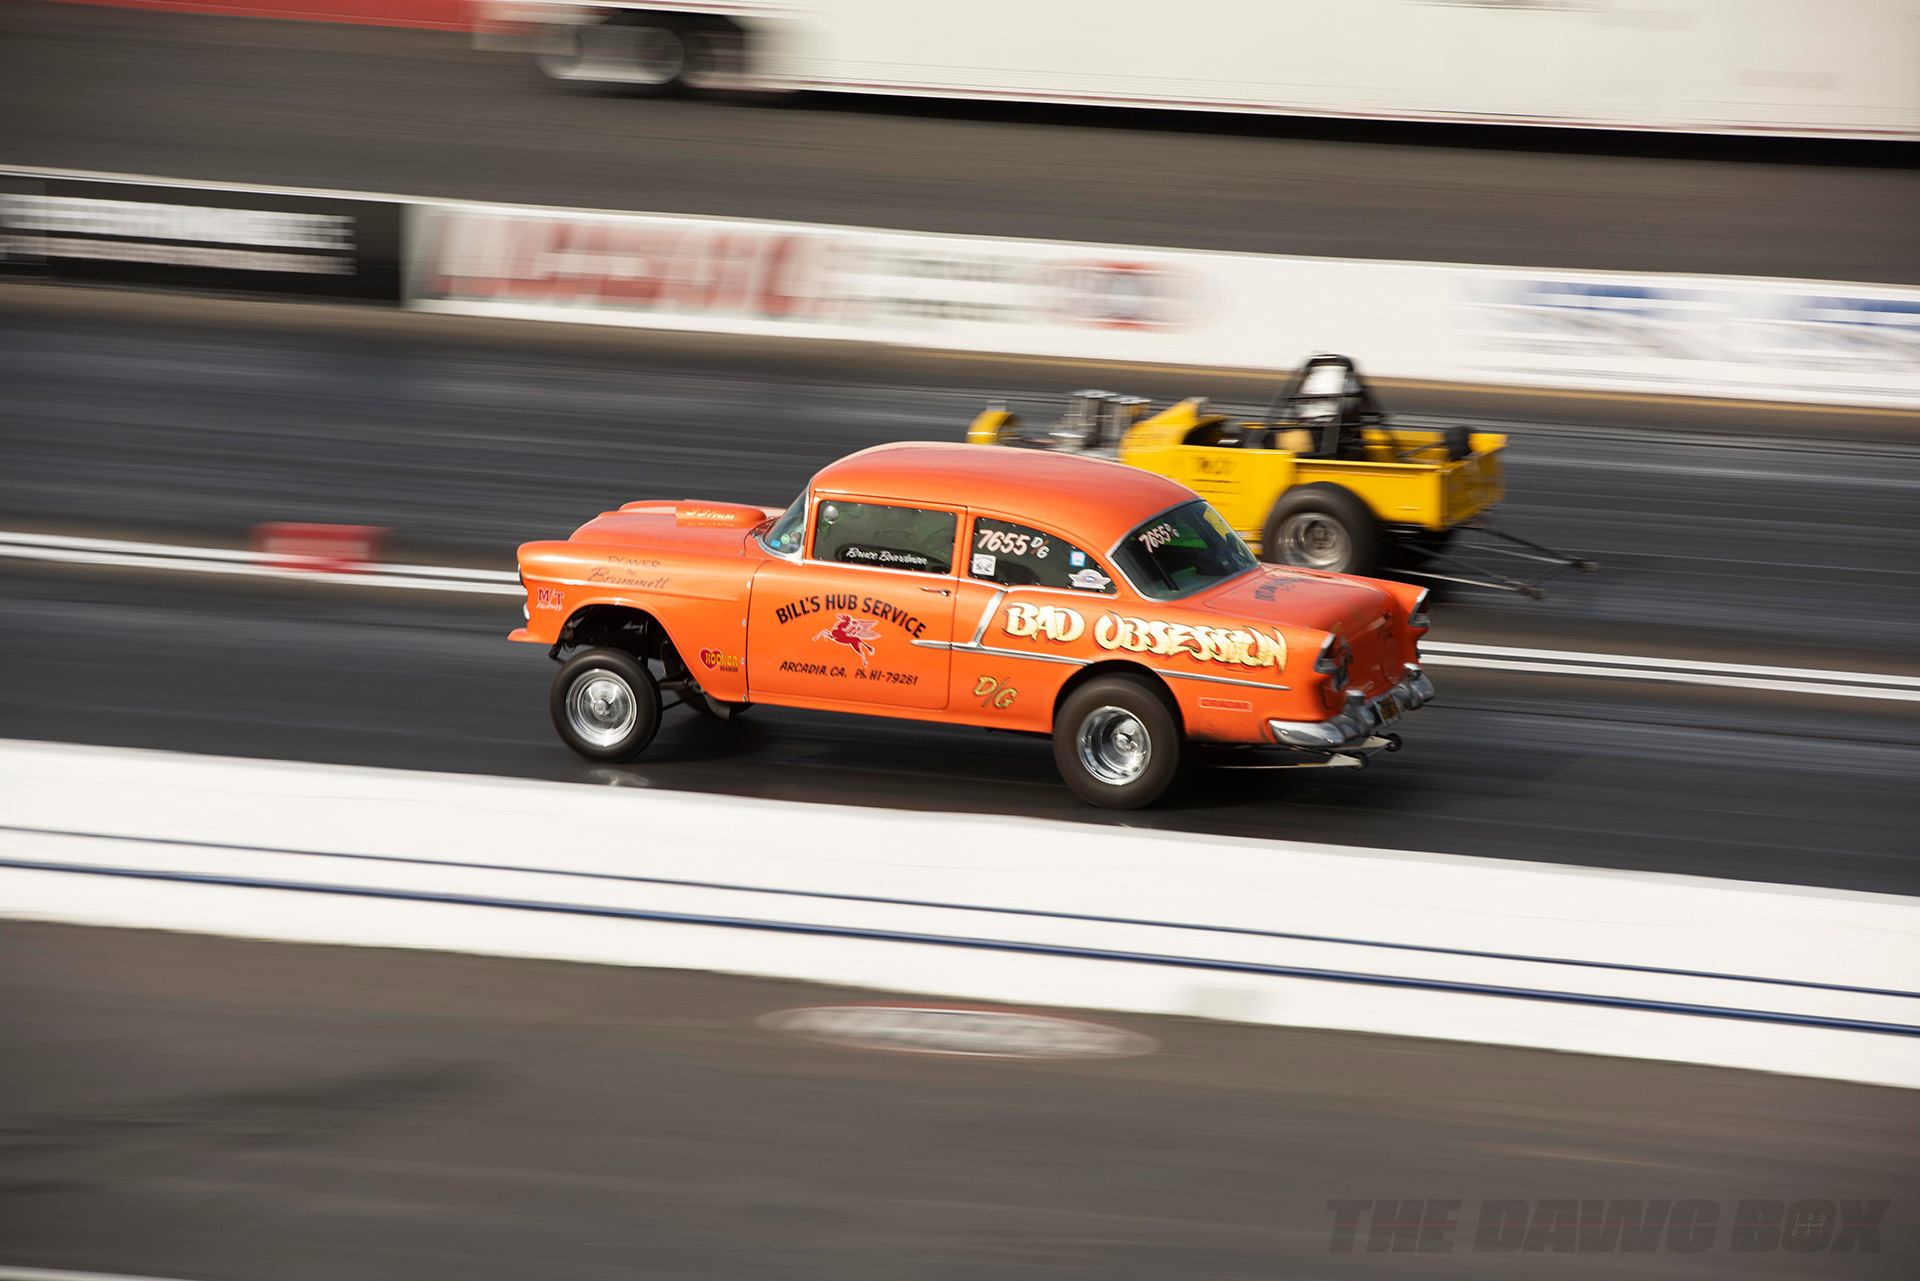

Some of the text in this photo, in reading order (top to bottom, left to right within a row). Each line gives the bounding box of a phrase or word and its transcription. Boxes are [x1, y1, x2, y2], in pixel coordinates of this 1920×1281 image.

[978, 529, 1031, 556] 7655
[1138, 525, 1171, 553] 7655
[607, 556, 660, 568] POWER
[537, 587, 565, 605] M/T
[776, 595, 926, 638] BILL'S HUB SERVICE
[1002, 602, 1288, 675] BAD OBSESSION
[974, 675, 1018, 709] D/G
